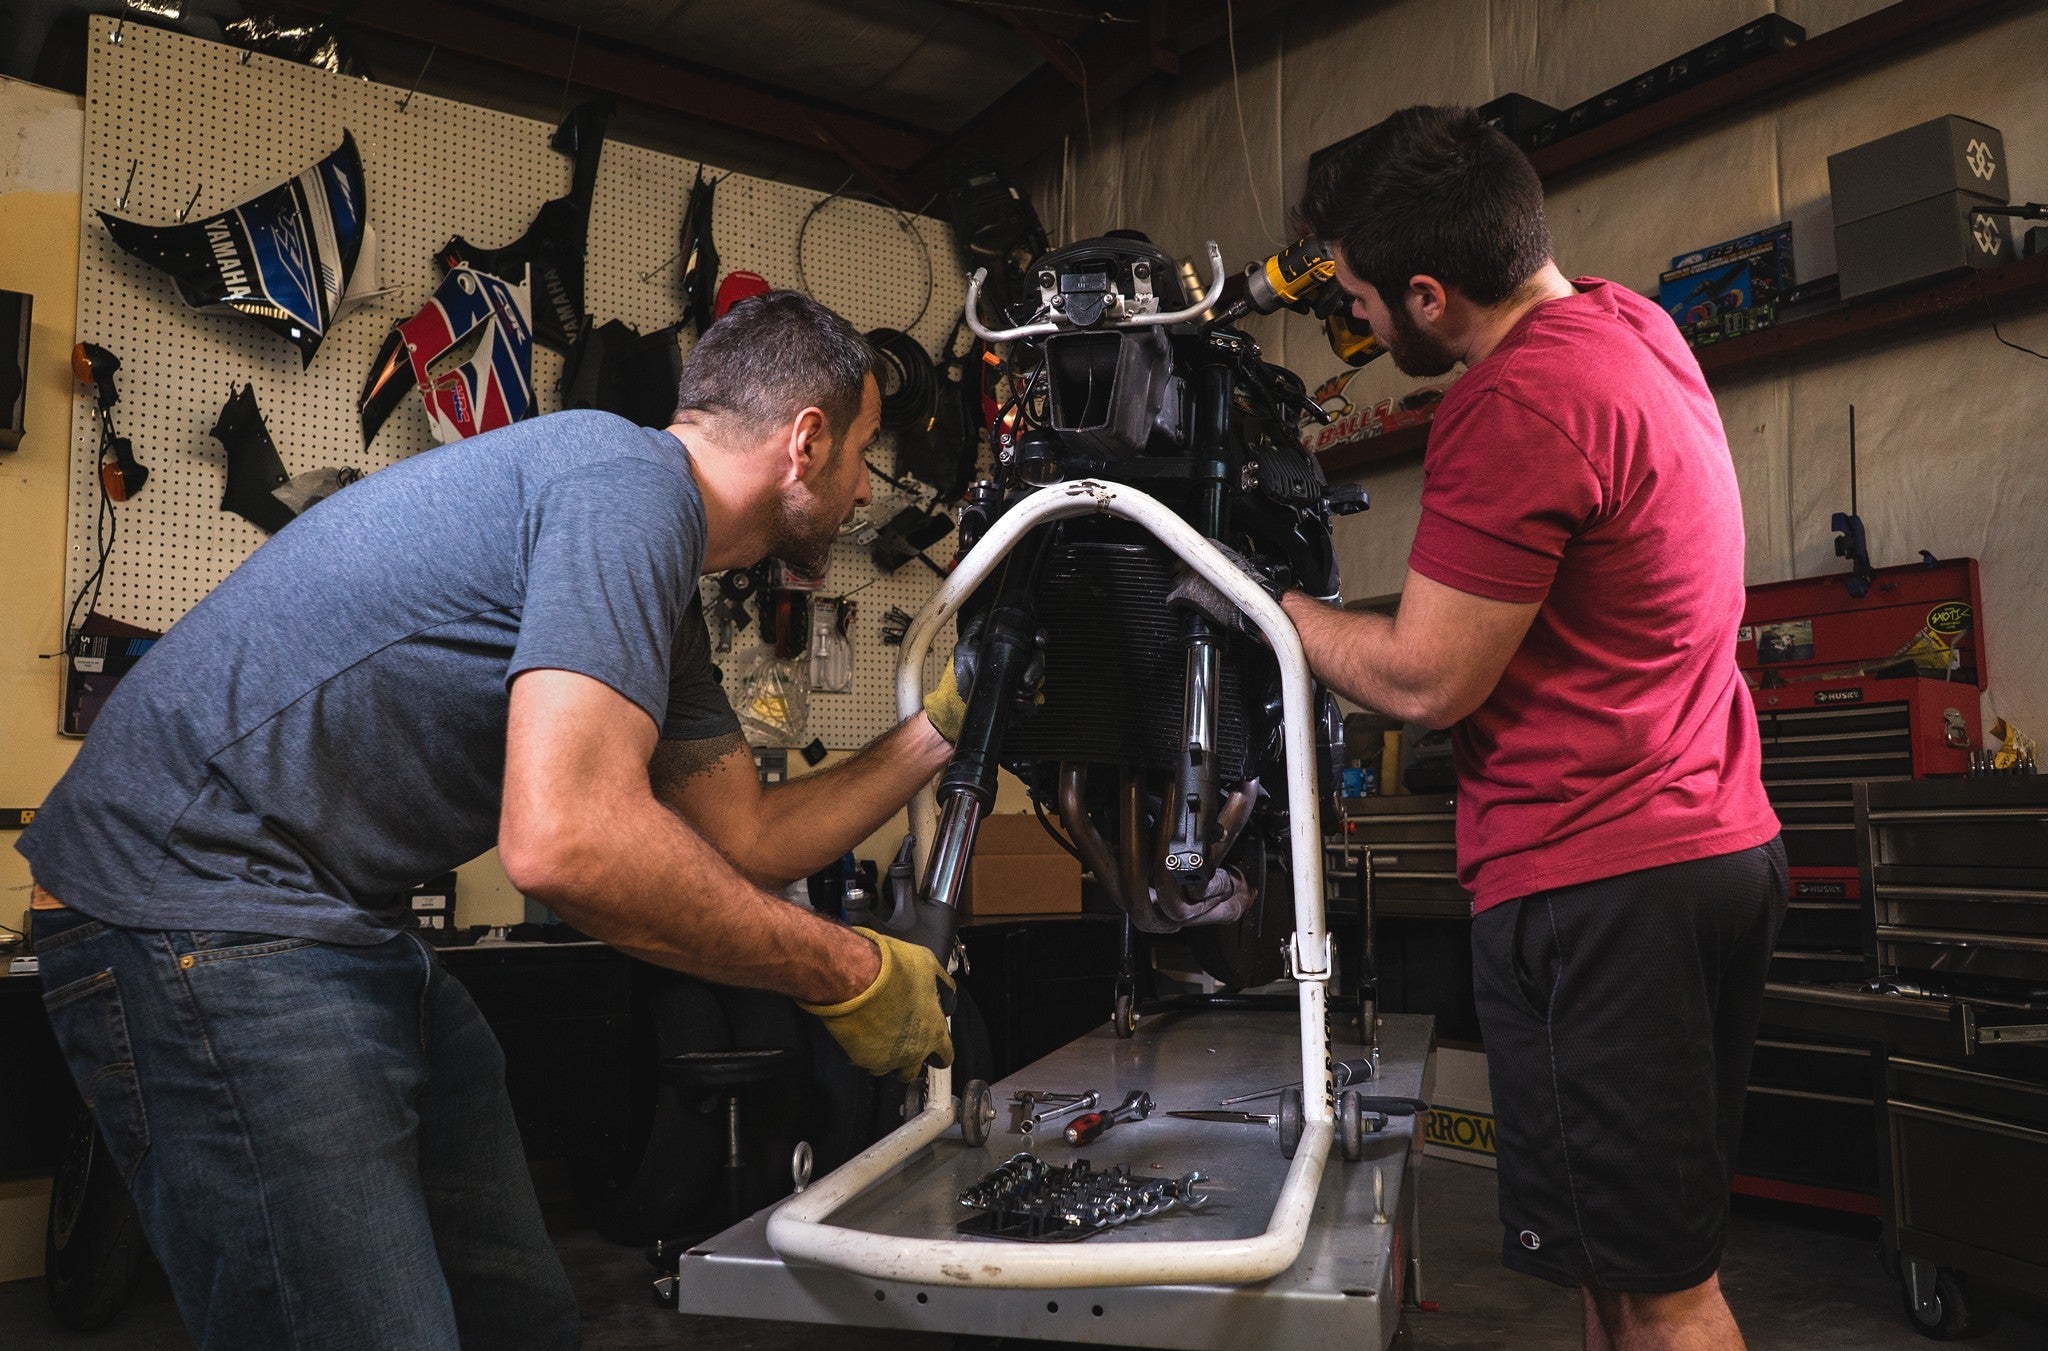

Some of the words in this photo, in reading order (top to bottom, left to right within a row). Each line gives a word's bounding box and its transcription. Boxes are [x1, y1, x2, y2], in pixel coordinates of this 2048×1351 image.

[205, 218, 252, 299] YAMAHA
[544, 267, 580, 345] YAMAHA
[1828, 691, 1859, 700] HUSKY
[1810, 885, 1841, 893] HUSKY
